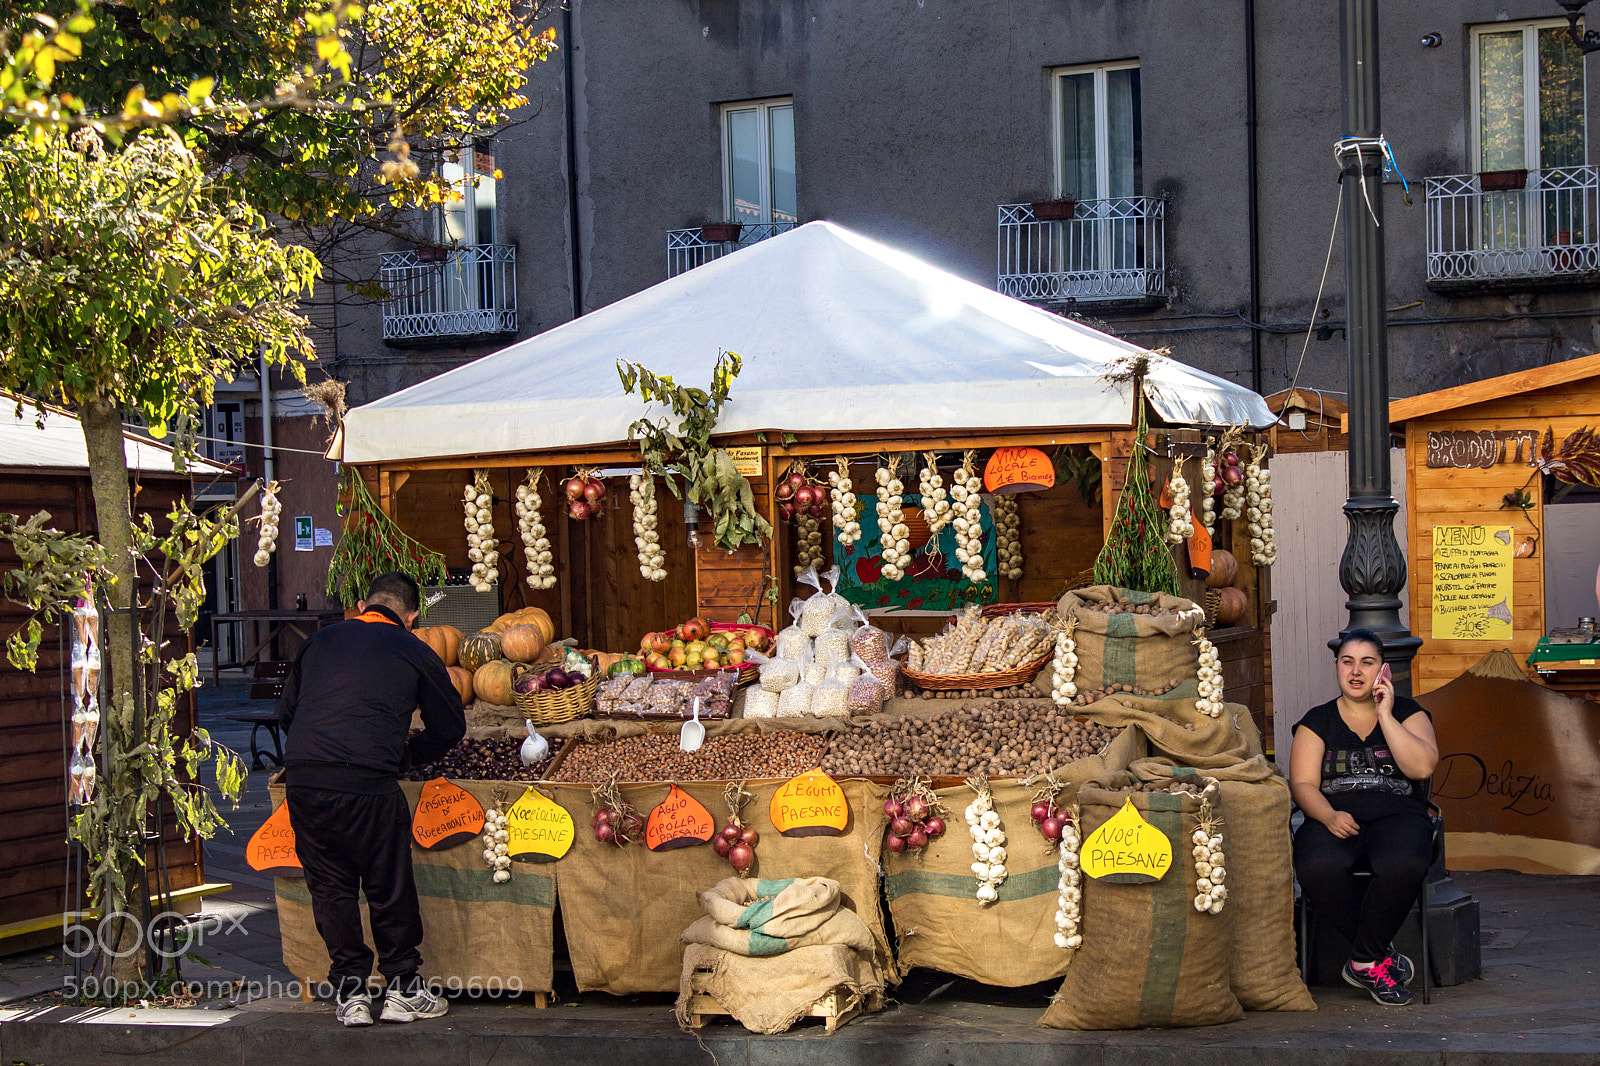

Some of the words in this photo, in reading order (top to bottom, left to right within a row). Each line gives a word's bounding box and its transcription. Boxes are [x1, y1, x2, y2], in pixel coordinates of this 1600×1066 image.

[996, 448, 1027, 464] VINO
[1427, 430, 1539, 468] PRODOTTI
[990, 458, 1038, 475] LOCALE
[783, 783, 836, 798] LEGUMI
[1431, 753, 1555, 816] Delizia
[657, 799, 687, 816] AGLIO
[781, 804, 842, 823] PAESANE
[260, 823, 296, 840] ZUCCH
[509, 826, 569, 842] PAESANE
[649, 815, 696, 838] CIPOLLA
[256, 845, 296, 861] PAESA
[1091, 849, 1168, 869] PAESANE
